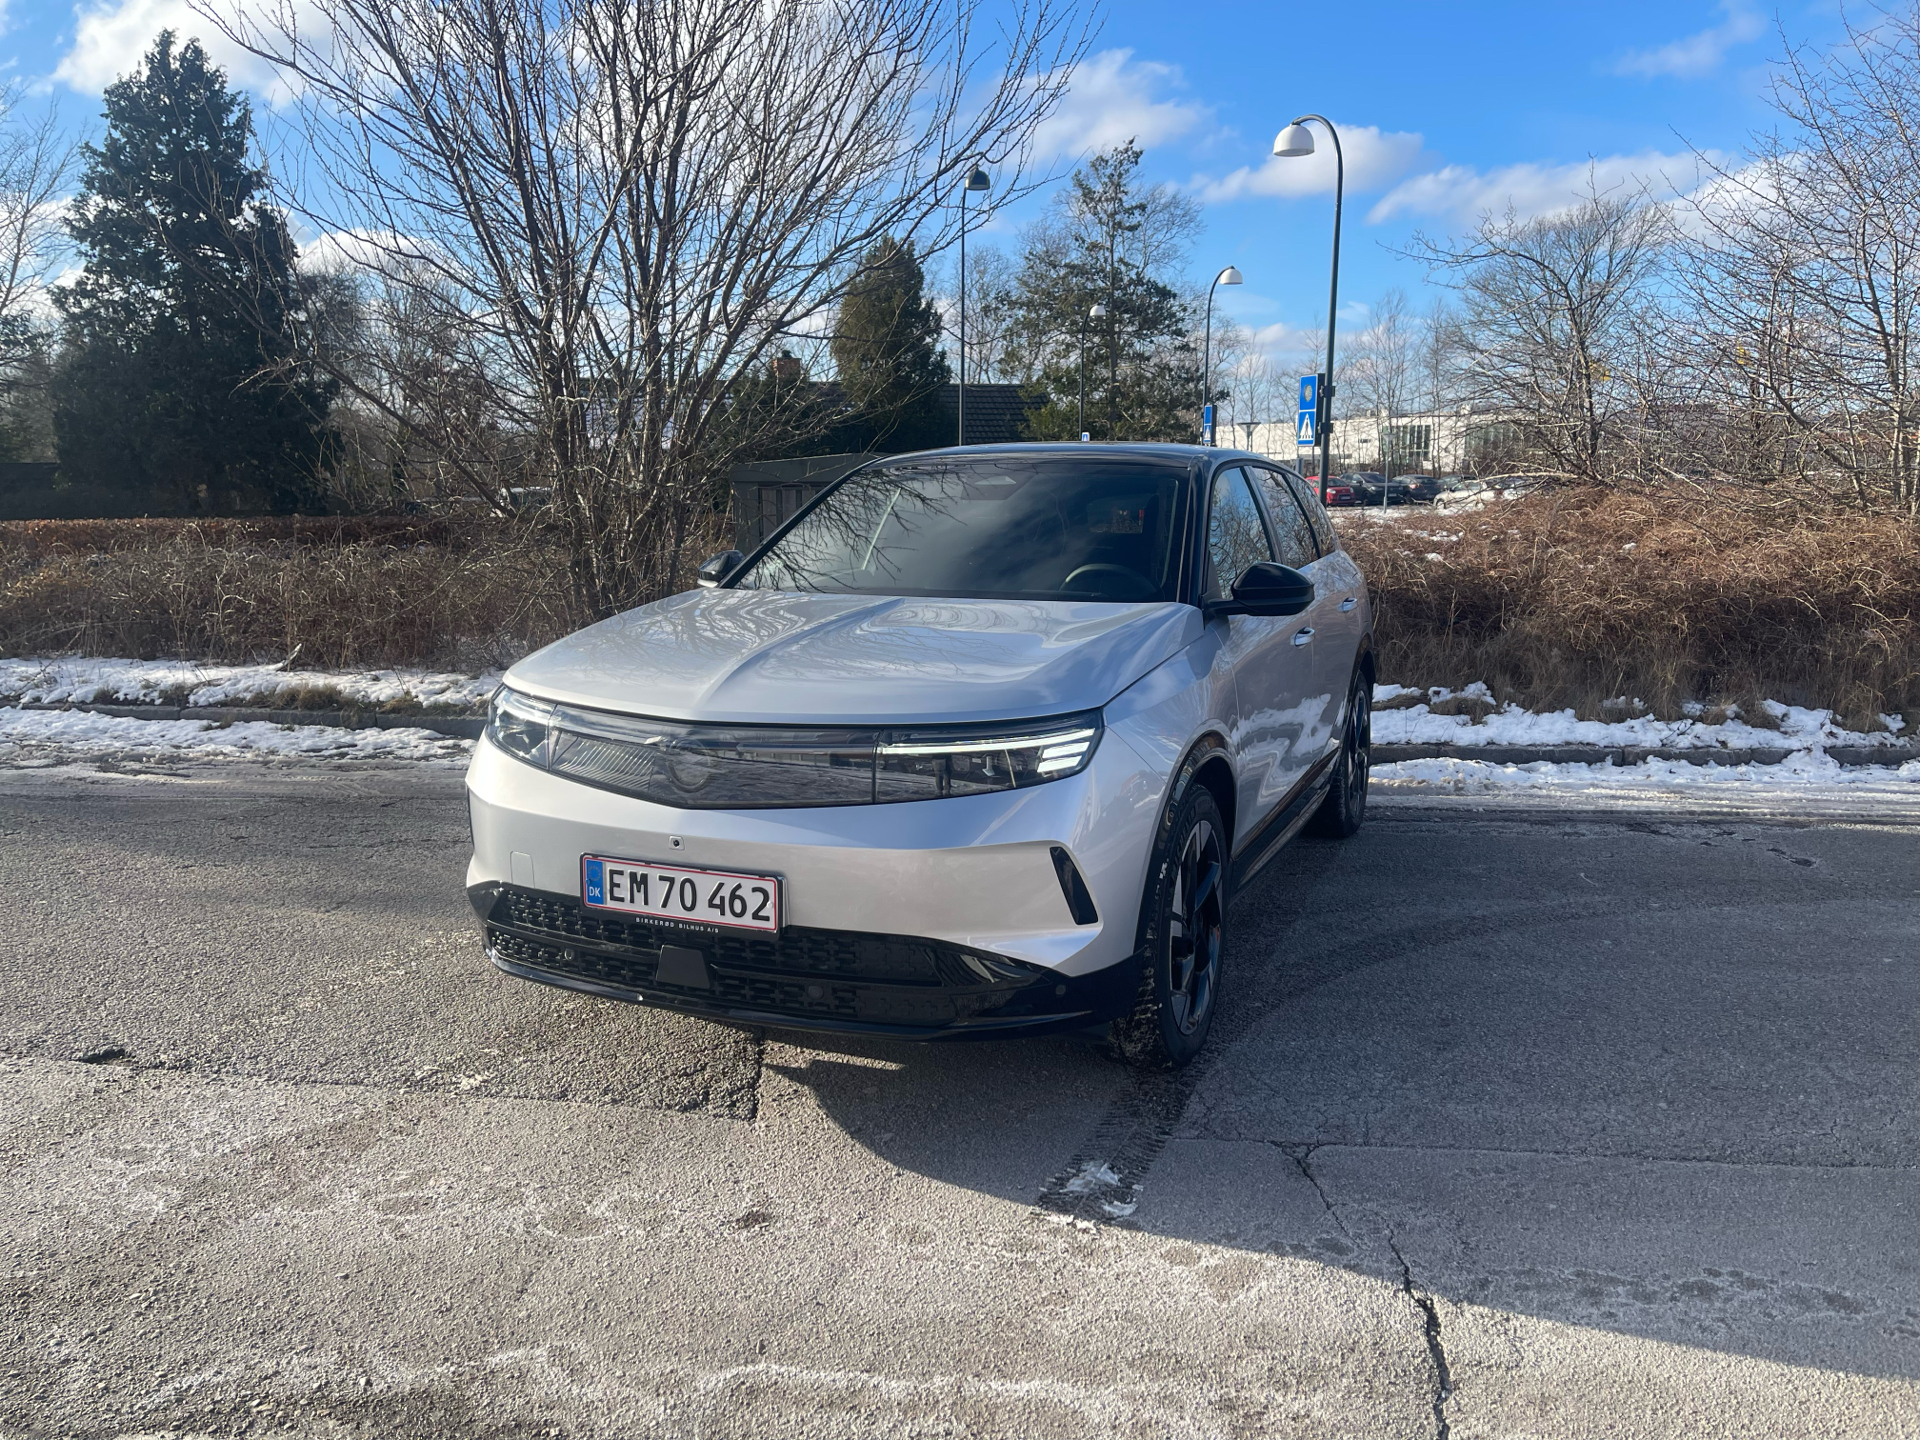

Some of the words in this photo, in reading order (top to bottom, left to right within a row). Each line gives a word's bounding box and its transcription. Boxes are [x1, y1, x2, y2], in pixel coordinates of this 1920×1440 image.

[589, 886, 601, 898] DK
[608, 868, 649, 906] EM
[658, 874, 697, 912] 70
[707, 881, 770, 922] 462
[678, 923, 704, 932] BILHUS
